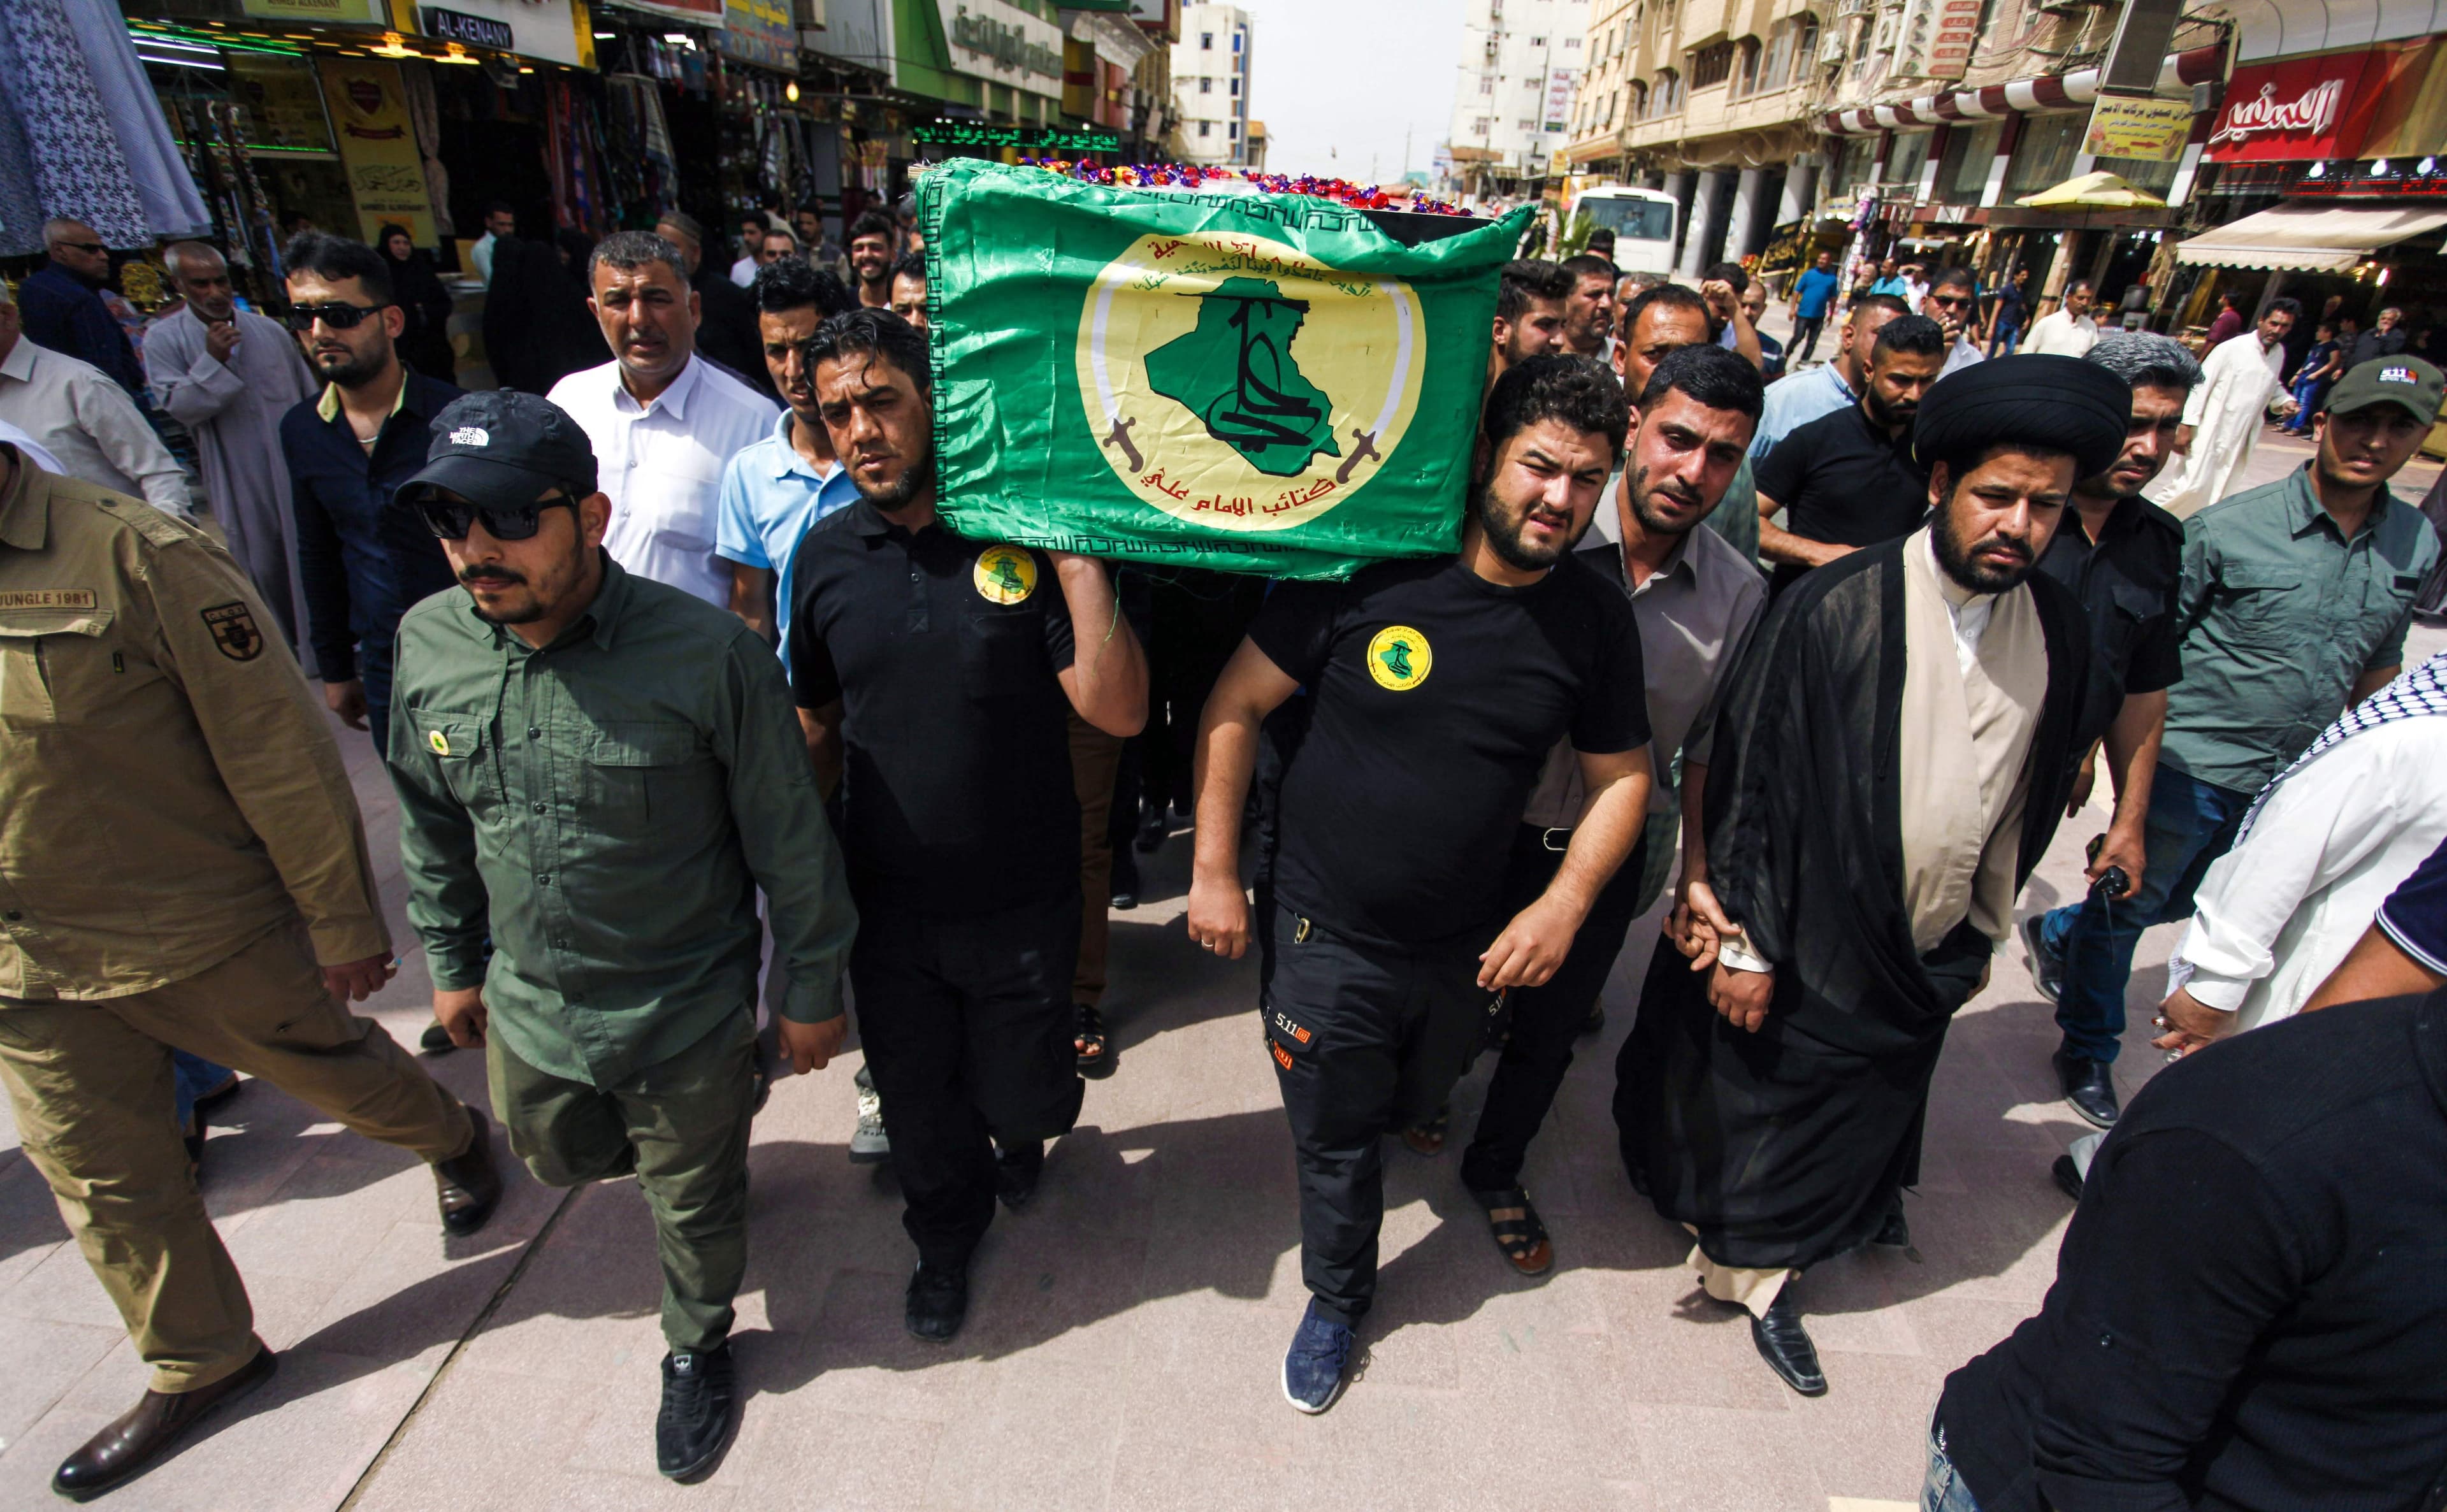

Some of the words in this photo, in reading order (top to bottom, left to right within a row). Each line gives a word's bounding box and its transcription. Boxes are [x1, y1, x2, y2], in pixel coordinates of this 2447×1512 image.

[437, 11, 509, 47] AL-KENANY
[2208, 79, 2344, 145] السفير
[449, 432, 476, 440] NORTH
[1139, 466, 1190, 501] علي
[1262, 478, 1336, 517] كتائب
[56, 593, 89, 605] 1981
[1275, 1012, 1297, 1037] 5.11
